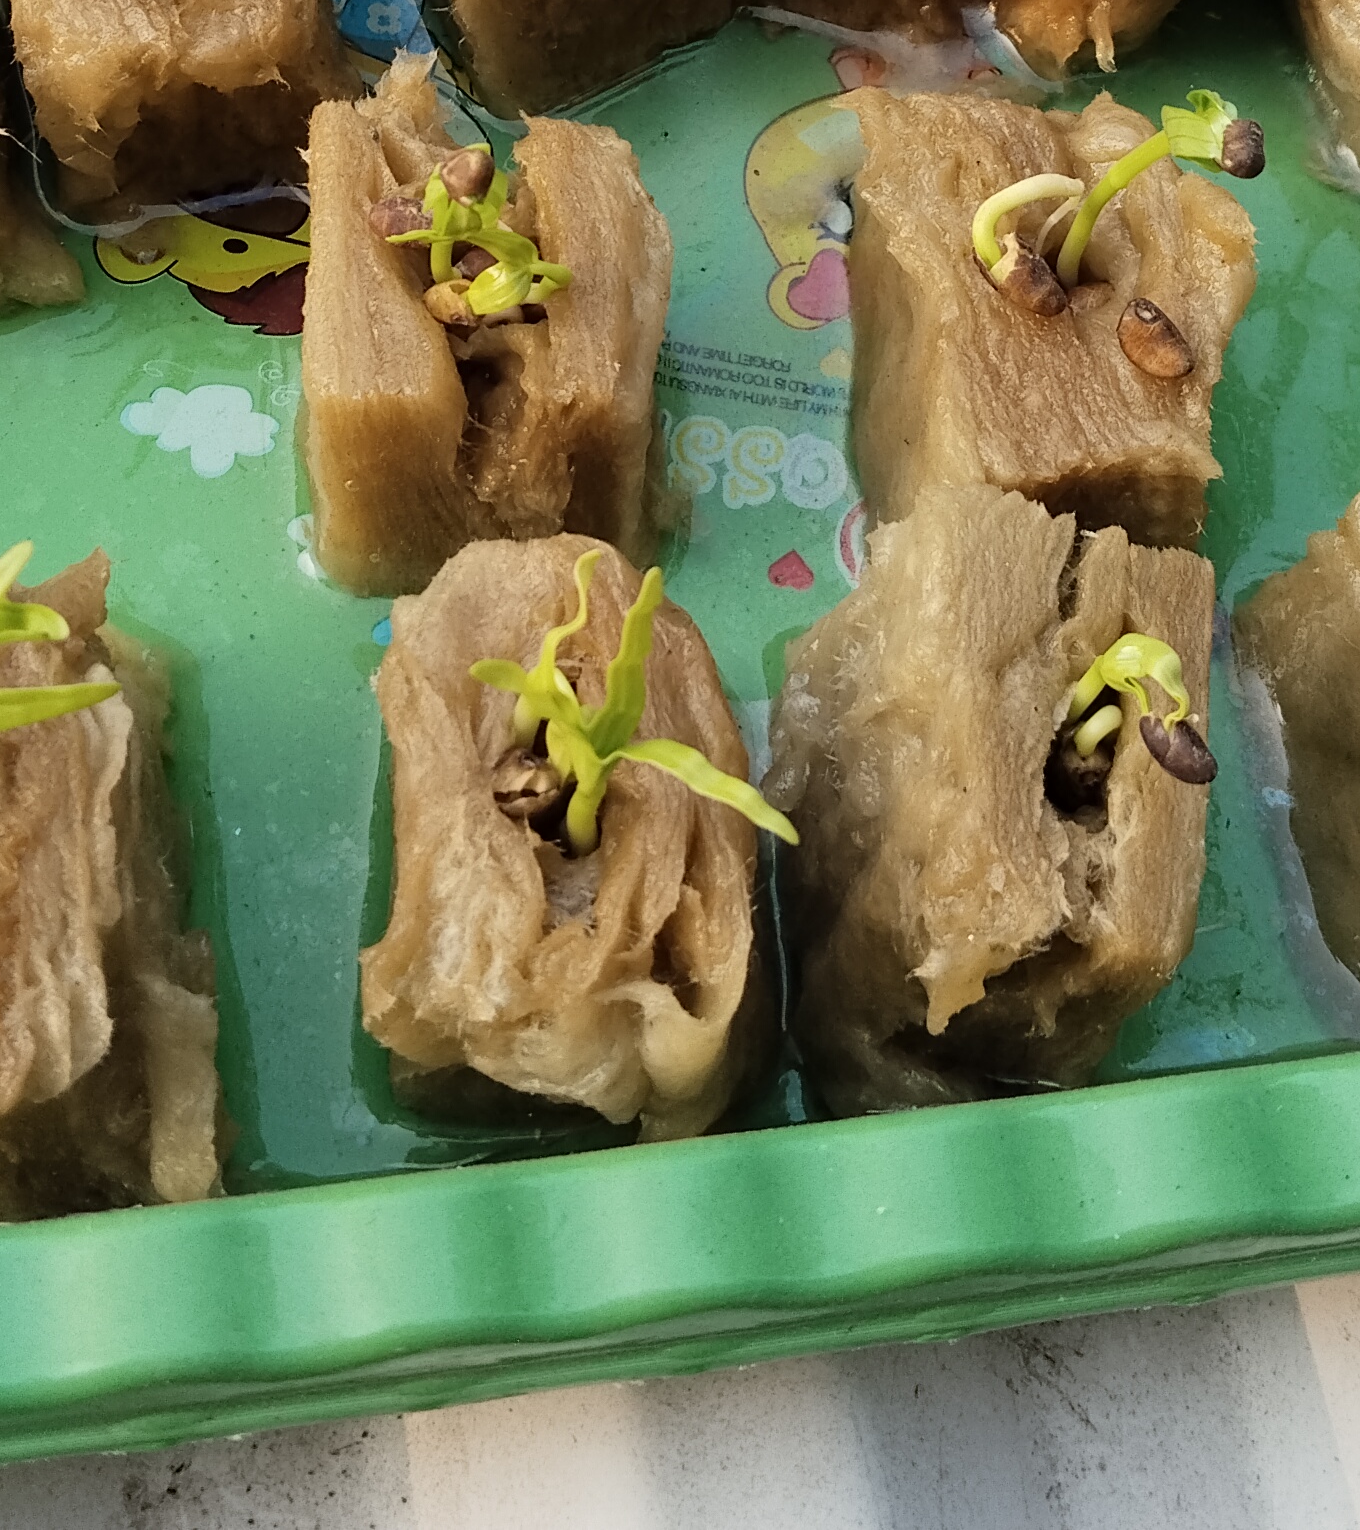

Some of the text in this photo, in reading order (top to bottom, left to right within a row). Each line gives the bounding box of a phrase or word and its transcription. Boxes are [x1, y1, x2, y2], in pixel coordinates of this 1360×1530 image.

[738, 353, 792, 373] FORGET
[742, 372, 772, 388] TOO
[780, 396, 807, 412] LIFE
